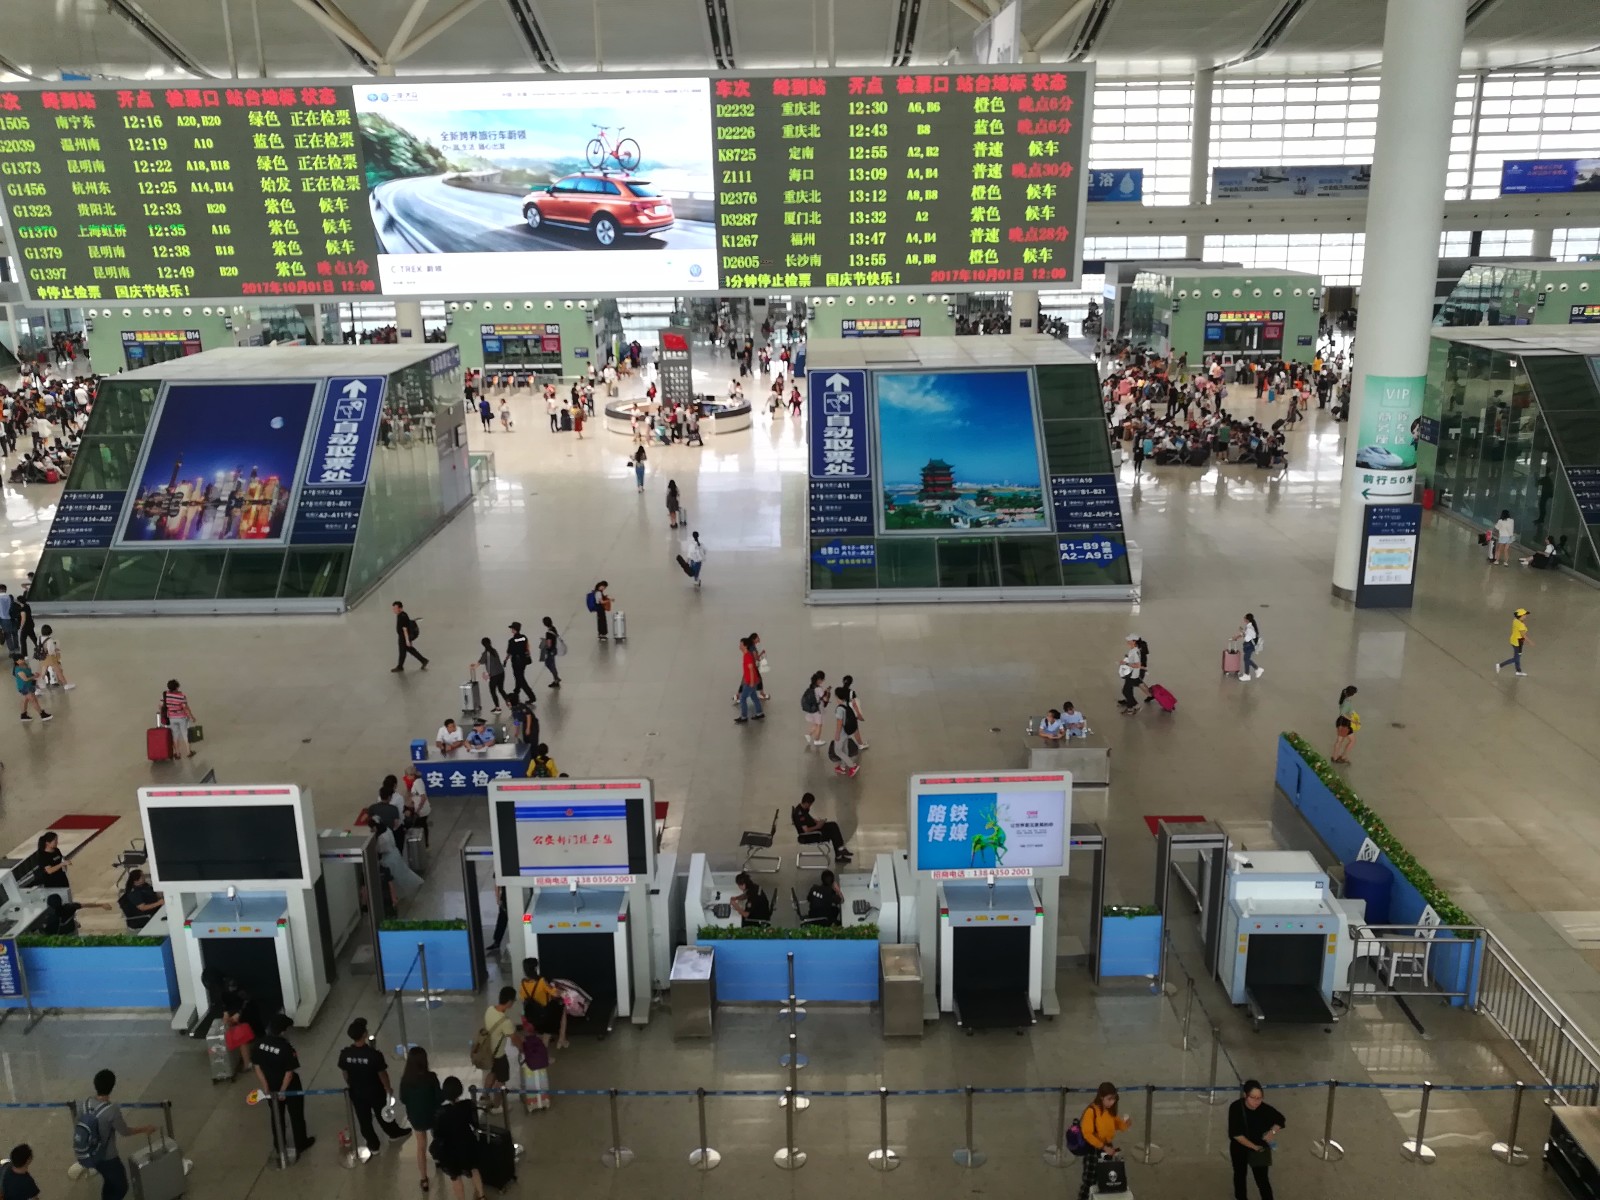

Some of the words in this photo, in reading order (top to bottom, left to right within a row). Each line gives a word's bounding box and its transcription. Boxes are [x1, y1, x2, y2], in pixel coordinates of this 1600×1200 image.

[716, 80, 750, 98] 车次
[849, 76, 883, 94] 开点
[1032, 73, 1066, 92] 状态
[0, 93, 21, 110] 次
[117, 90, 154, 108] 开点
[301, 87, 336, 106] 状态
[716, 104, 755, 117] D2232
[783, 101, 820, 116] 重庆北
[849, 101, 888, 115] 12:30
[973, 96, 1006, 114] 橙色
[56, 115, 94, 130] 南宁东
[124, 116, 163, 129] 12:16
[177, 115, 222, 128] A20,B20
[248, 111, 281, 127] 绿色
[291, 110, 351, 127] 正在检票
[783, 124, 821, 139] 重庆北
[849, 124, 888, 138] 12:43
[973, 119, 1004, 136] 蓝色
[60, 138, 101, 152] 温州南
[129, 138, 168, 151] 12:19
[193, 138, 214, 150] A10
[253, 133, 285, 150] 蓝色
[295, 132, 355, 149] 正在检票
[718, 148, 757, 162] K8725
[849, 145, 888, 160] 12:55
[907, 146, 940, 159] A2,B2
[973, 142, 1004, 159] 普速
[1028, 140, 1059, 157] 候车
[2, 161, 42, 175] G1373
[67, 160, 106, 174] 昆明南
[134, 160, 173, 173] 12:22
[186, 160, 230, 173] A18,B18
[256, 155, 288, 172] 绿色
[298, 154, 358, 171] 正在检票
[723, 171, 751, 184] Z111
[788, 168, 814, 181] 海口
[849, 167, 888, 181] 13:09
[906, 168, 938, 180] A4,B4
[972, 163, 1003, 180] 普速
[7, 183, 46, 196] G1456
[72, 181, 110, 195] 杭州东
[138, 181, 178, 195] 12:25
[191, 181, 234, 193] A14,B14
[261, 176, 292, 193] 始发
[302, 175, 361, 192] 正在检票
[720, 192, 757, 205] D2376
[784, 190, 821, 204] 重庆北
[849, 190, 887, 203] 13:12
[970, 185, 1002, 201] 橙色
[1026, 183, 1056, 200] 候车
[13, 205, 52, 218] G1323
[77, 203, 116, 217] 贵阳北
[144, 203, 181, 216] 12:33
[207, 204, 227, 214] B20
[264, 198, 296, 214] 紫色
[319, 197, 348, 213] 候车
[784, 211, 821, 225] 厦门北
[849, 211, 886, 224] 13:32
[915, 211, 929, 222] A2
[970, 206, 1000, 223] 紫色
[1025, 205, 1054, 222] 候车
[18, 225, 58, 239] G1370
[77, 224, 128, 239] 上海虹桥
[148, 223, 187, 237] 12:35
[211, 225, 231, 235] A16
[268, 219, 299, 235] 紫色
[322, 219, 352, 235] 候车
[722, 234, 759, 248] K1267
[790, 233, 816, 246] 福州
[849, 231, 886, 246] 13:47
[905, 232, 936, 244] A4,B4
[970, 228, 1000, 244] 普速
[24, 247, 63, 260] G1379
[87, 245, 126, 259] 昆明南
[153, 245, 191, 258] 12:38
[215, 245, 235, 256] B18
[272, 240, 303, 256] 紫色
[325, 240, 354, 255] 候车
[722, 256, 759, 269] D2605
[785, 254, 822, 267] 长沙南
[849, 253, 886, 267] 13:55
[968, 249, 999, 265] 橙色
[1023, 248, 1053, 264] 候车
[29, 268, 67, 281] G1397
[93, 266, 131, 279] 昆明南
[157, 266, 195, 279] 12:49
[219, 267, 239, 277] B20
[275, 261, 307, 278] 紫色
[1572, 306, 1584, 314] B7
[1386, 388, 1410, 400] VIP
[320, 421, 359, 483] 自动取票处
[823, 414, 855, 475] 自动取票处
[1364, 474, 1412, 485] 前行50米
[1060, 542, 1099, 550] B1-B9
[1061, 552, 1101, 560] A2-A9
[928, 823, 968, 842] 传媒
[1010, 868, 1030, 876] 2001
